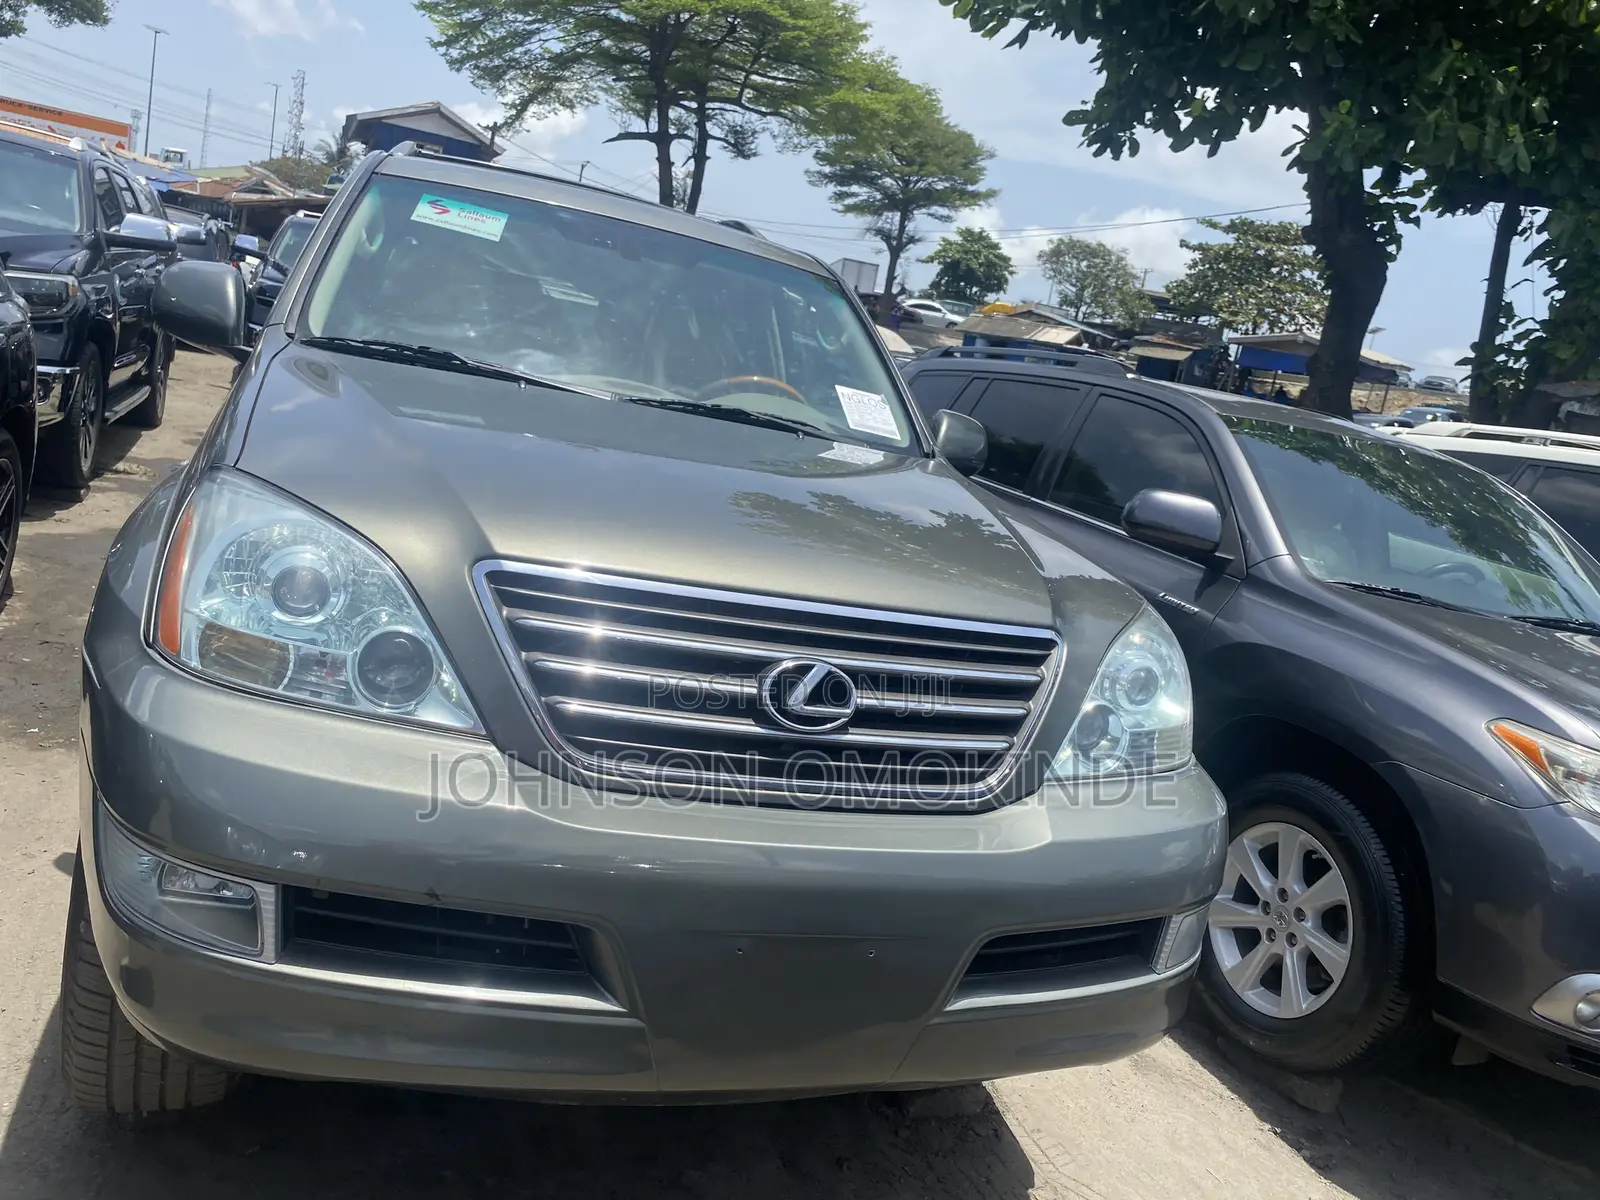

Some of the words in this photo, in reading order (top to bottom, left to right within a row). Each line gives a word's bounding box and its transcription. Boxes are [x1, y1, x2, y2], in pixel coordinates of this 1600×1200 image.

[27, 104, 63, 116] SERVICE
[457, 212, 486, 224] Lines
[459, 207, 501, 222] Sallaum
[841, 391, 887, 410] NGLOS
